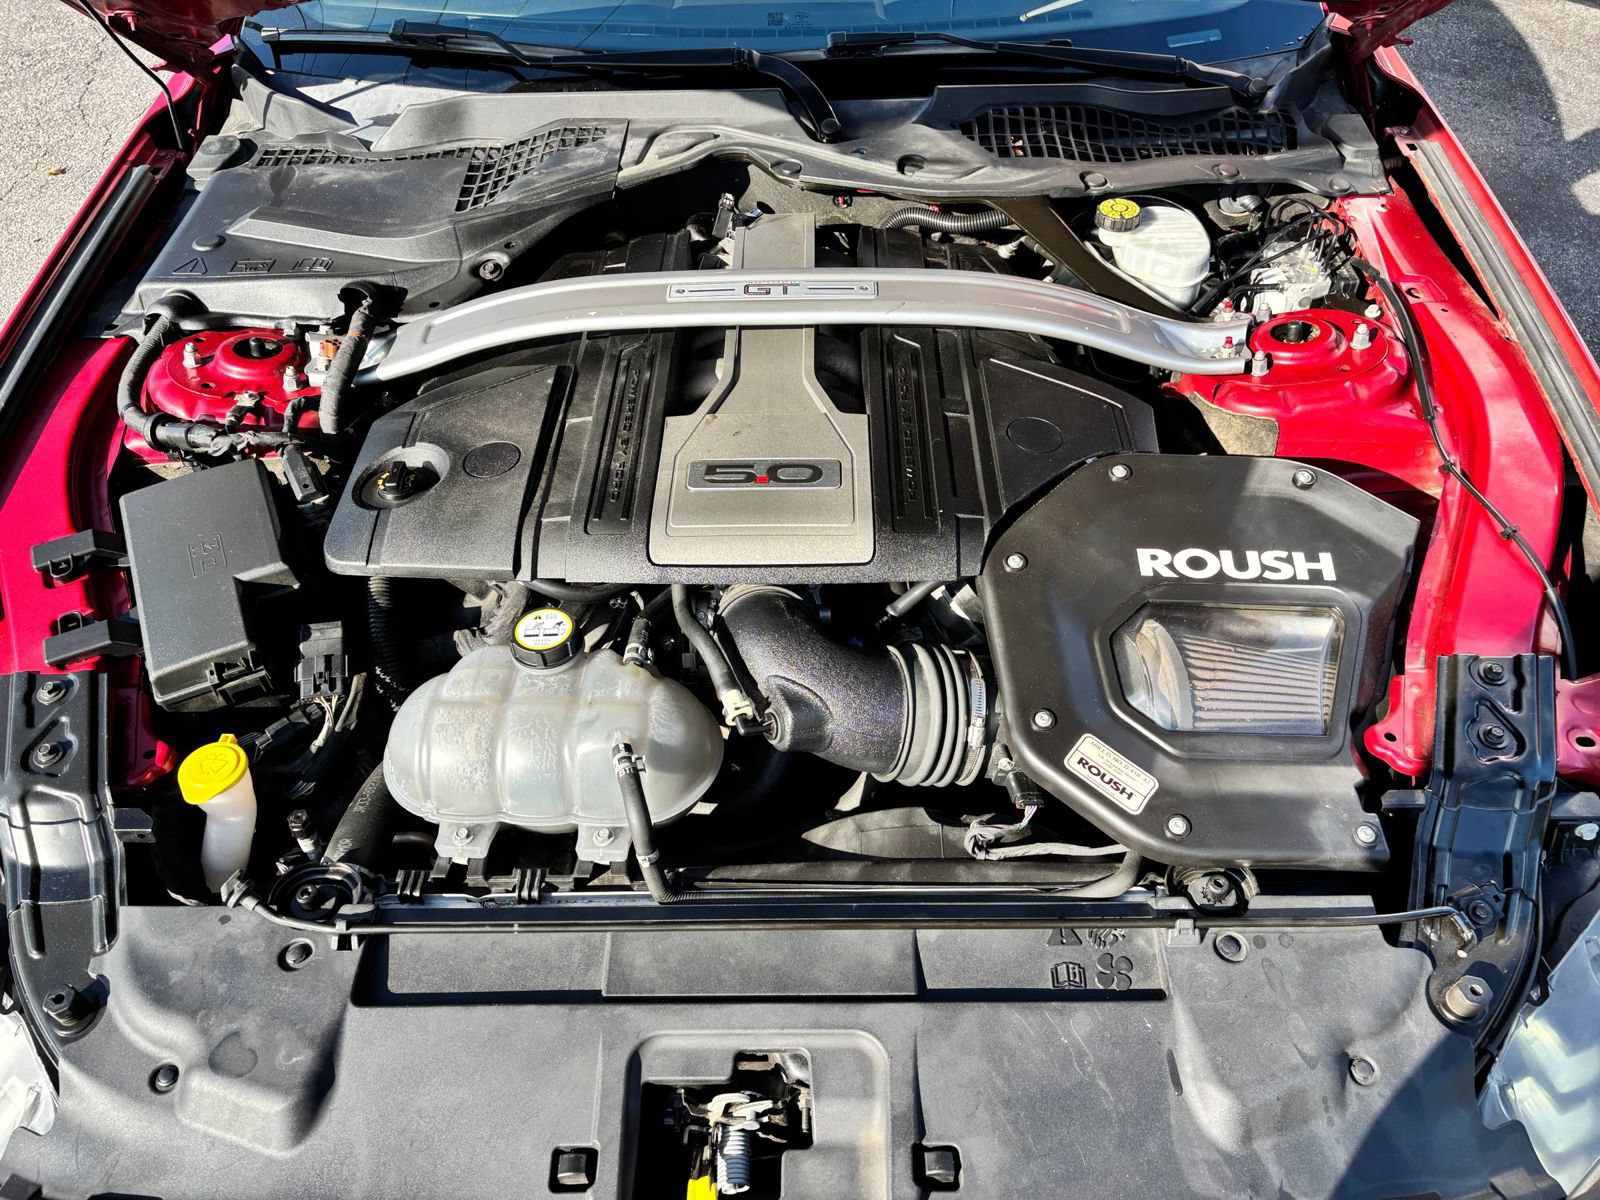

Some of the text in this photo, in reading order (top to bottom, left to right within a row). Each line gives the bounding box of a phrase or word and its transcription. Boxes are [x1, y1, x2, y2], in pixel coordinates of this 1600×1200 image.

[744, 283, 800, 295] GT
[898, 367, 910, 401] FORD
[610, 369, 640, 503] POWERED BY FORD
[704, 463, 823, 484] 5.0
[1136, 548, 1336, 581] ROUSH
[1077, 757, 1134, 800] ROUSH
